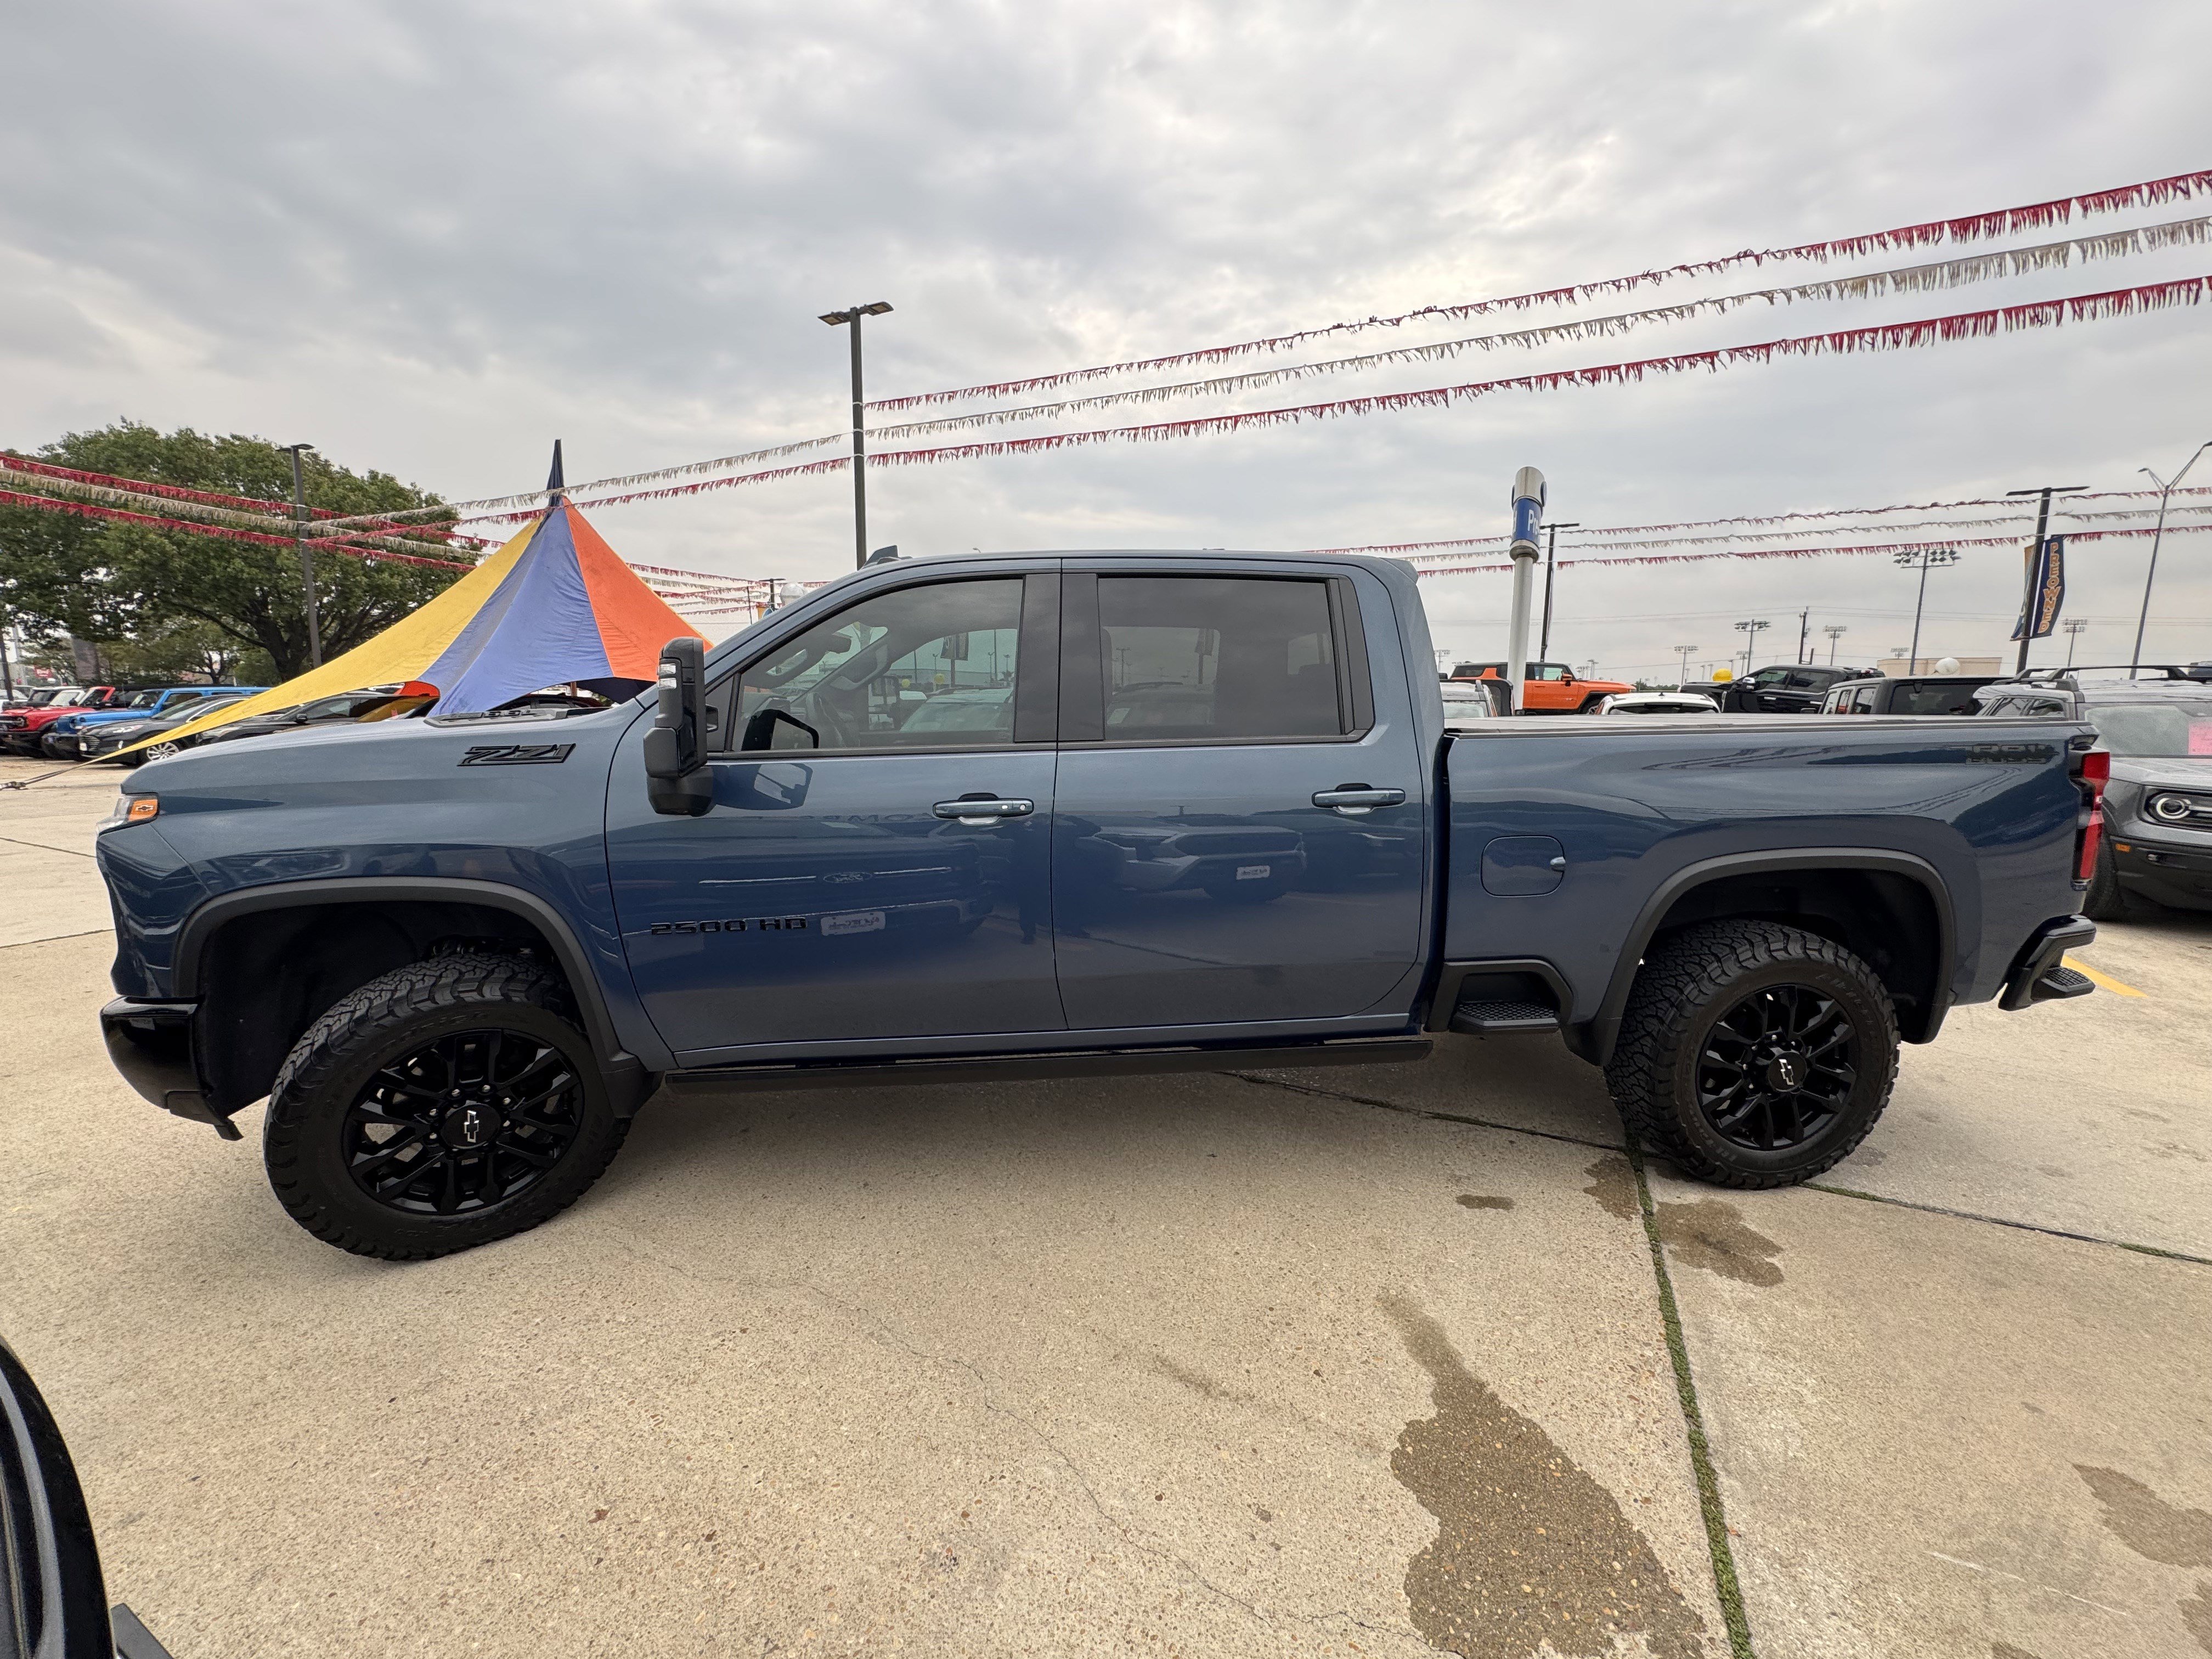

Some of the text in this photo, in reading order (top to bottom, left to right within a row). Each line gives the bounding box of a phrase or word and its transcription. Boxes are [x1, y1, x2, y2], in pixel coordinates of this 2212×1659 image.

[2038, 542, 2062, 634] PREOWNED
[456, 743, 577, 767] Z71
[650, 919, 747, 935] 2500
[759, 916, 808, 932] HD
